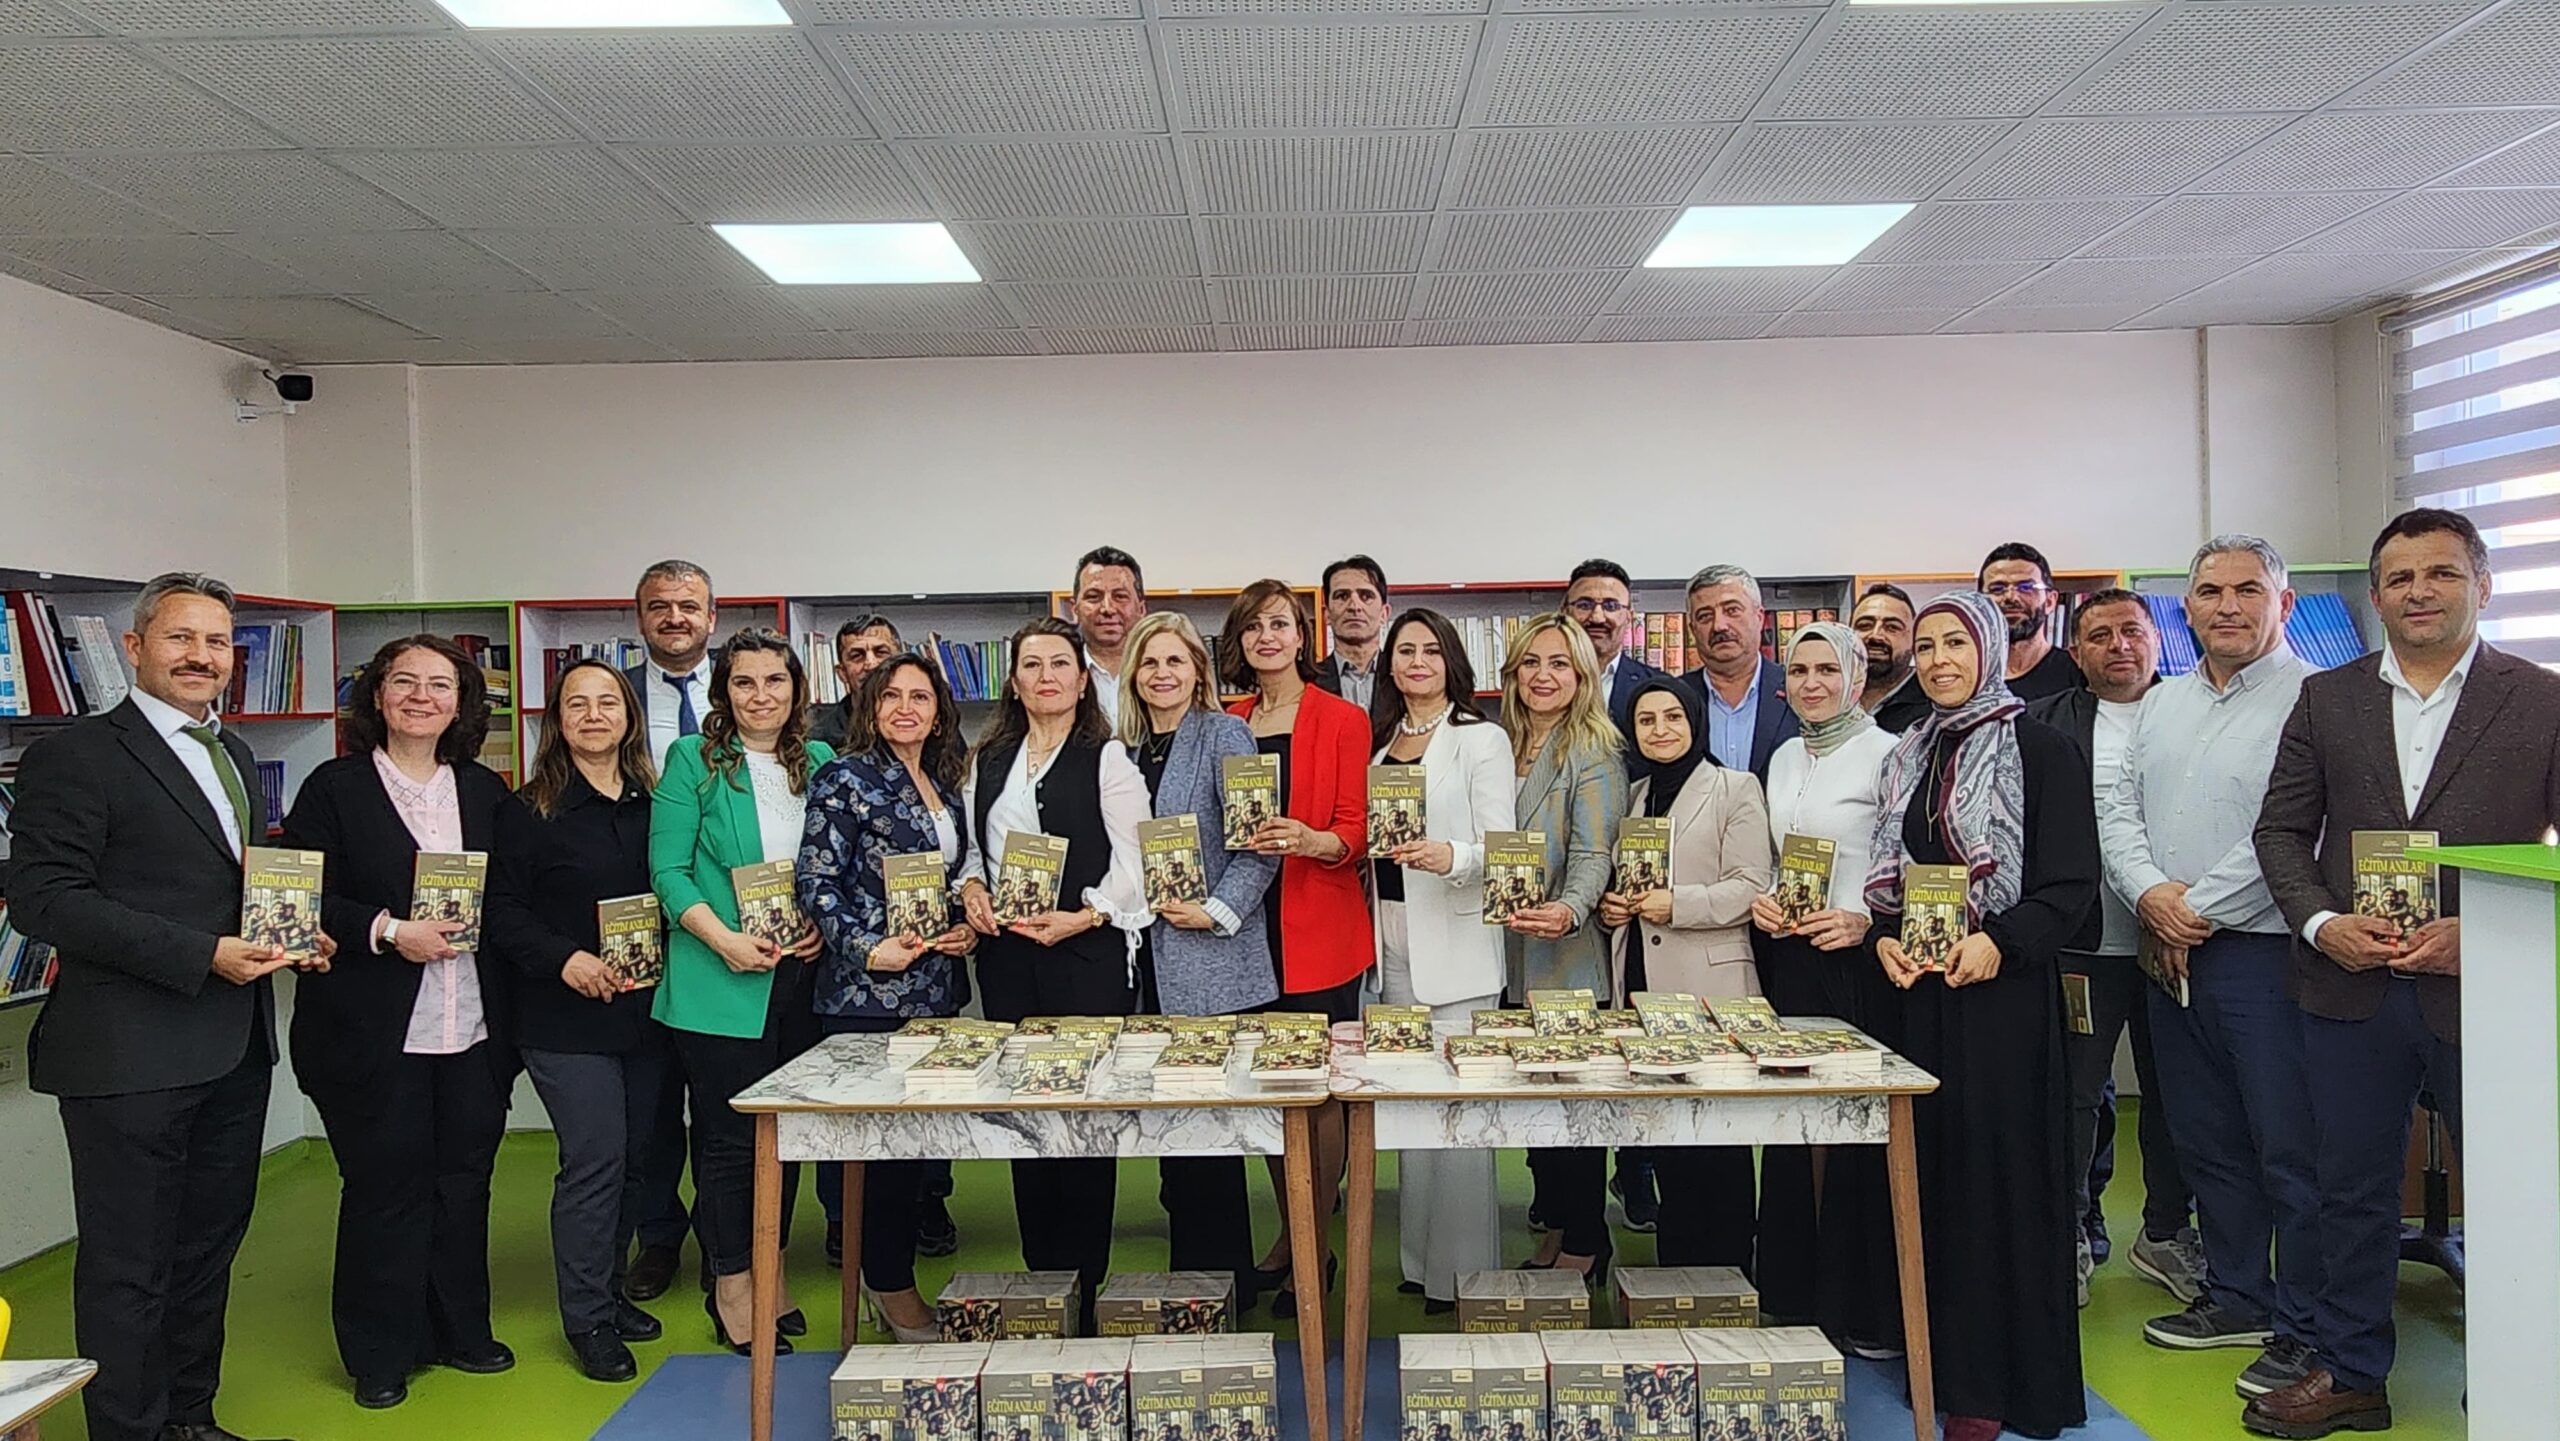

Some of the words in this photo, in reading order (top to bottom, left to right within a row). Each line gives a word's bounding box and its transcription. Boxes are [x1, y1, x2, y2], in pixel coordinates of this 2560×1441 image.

[2358, 857, 2388, 872] EĞİTİM
[2389, 860, 2426, 873] ANILARI
[1209, 1390, 1235, 1405] EĞİTİM
[1236, 1391, 1268, 1404] ANILARI
[1478, 1392, 1503, 1406] EĞİTİM
[1505, 1394, 1537, 1406] ANILARI
[1555, 1388, 1581, 1402] EĞİTİM
[1582, 1390, 1614, 1402] ANILARI
[1706, 1387, 1732, 1401] EĞİTİM
[1733, 1389, 1765, 1401] ANILARI
[1777, 1386, 1803, 1400] EĞİTİM
[1804, 1387, 1836, 1400] ANILARI
[987, 1399, 1012, 1412] EĞİTİM
[1014, 1401, 1046, 1412] ANILARI
[1136, 1395, 1162, 1409] EĞİTİM
[1163, 1397, 1196, 1408] ANILARI
[1407, 1394, 1433, 1407] EĞİTİM
[1434, 1396, 1466, 1407] ANILARI
[836, 1404, 862, 1418] EĞİTİM
[864, 1406, 896, 1417] ANILARI
